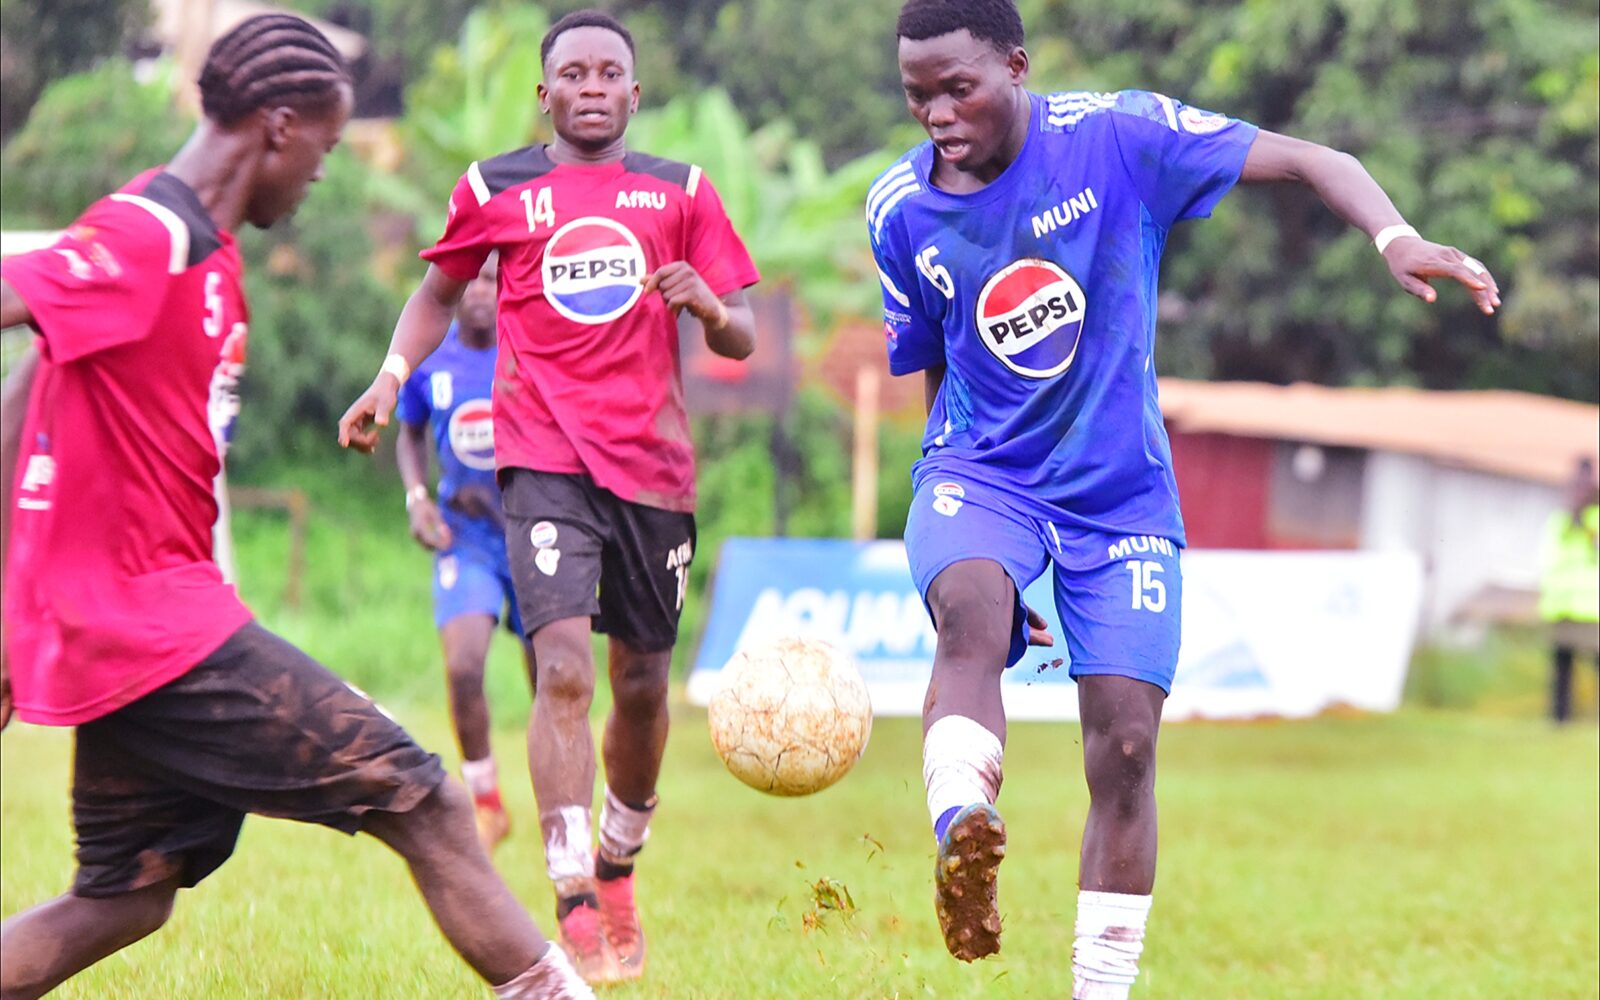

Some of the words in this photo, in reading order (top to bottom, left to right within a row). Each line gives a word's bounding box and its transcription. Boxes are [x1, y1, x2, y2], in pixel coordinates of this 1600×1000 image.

[519, 186, 555, 233] 14
[615, 190, 666, 210] AfRU
[1031, 187, 1098, 239] MUNI
[549, 257, 638, 283] PEPSI
[914, 245, 955, 300] 15
[202, 271, 224, 337] 5
[988, 291, 1078, 345] PEPSI
[1108, 534, 1174, 560] MUNI
[1125, 559, 1167, 613] 15
